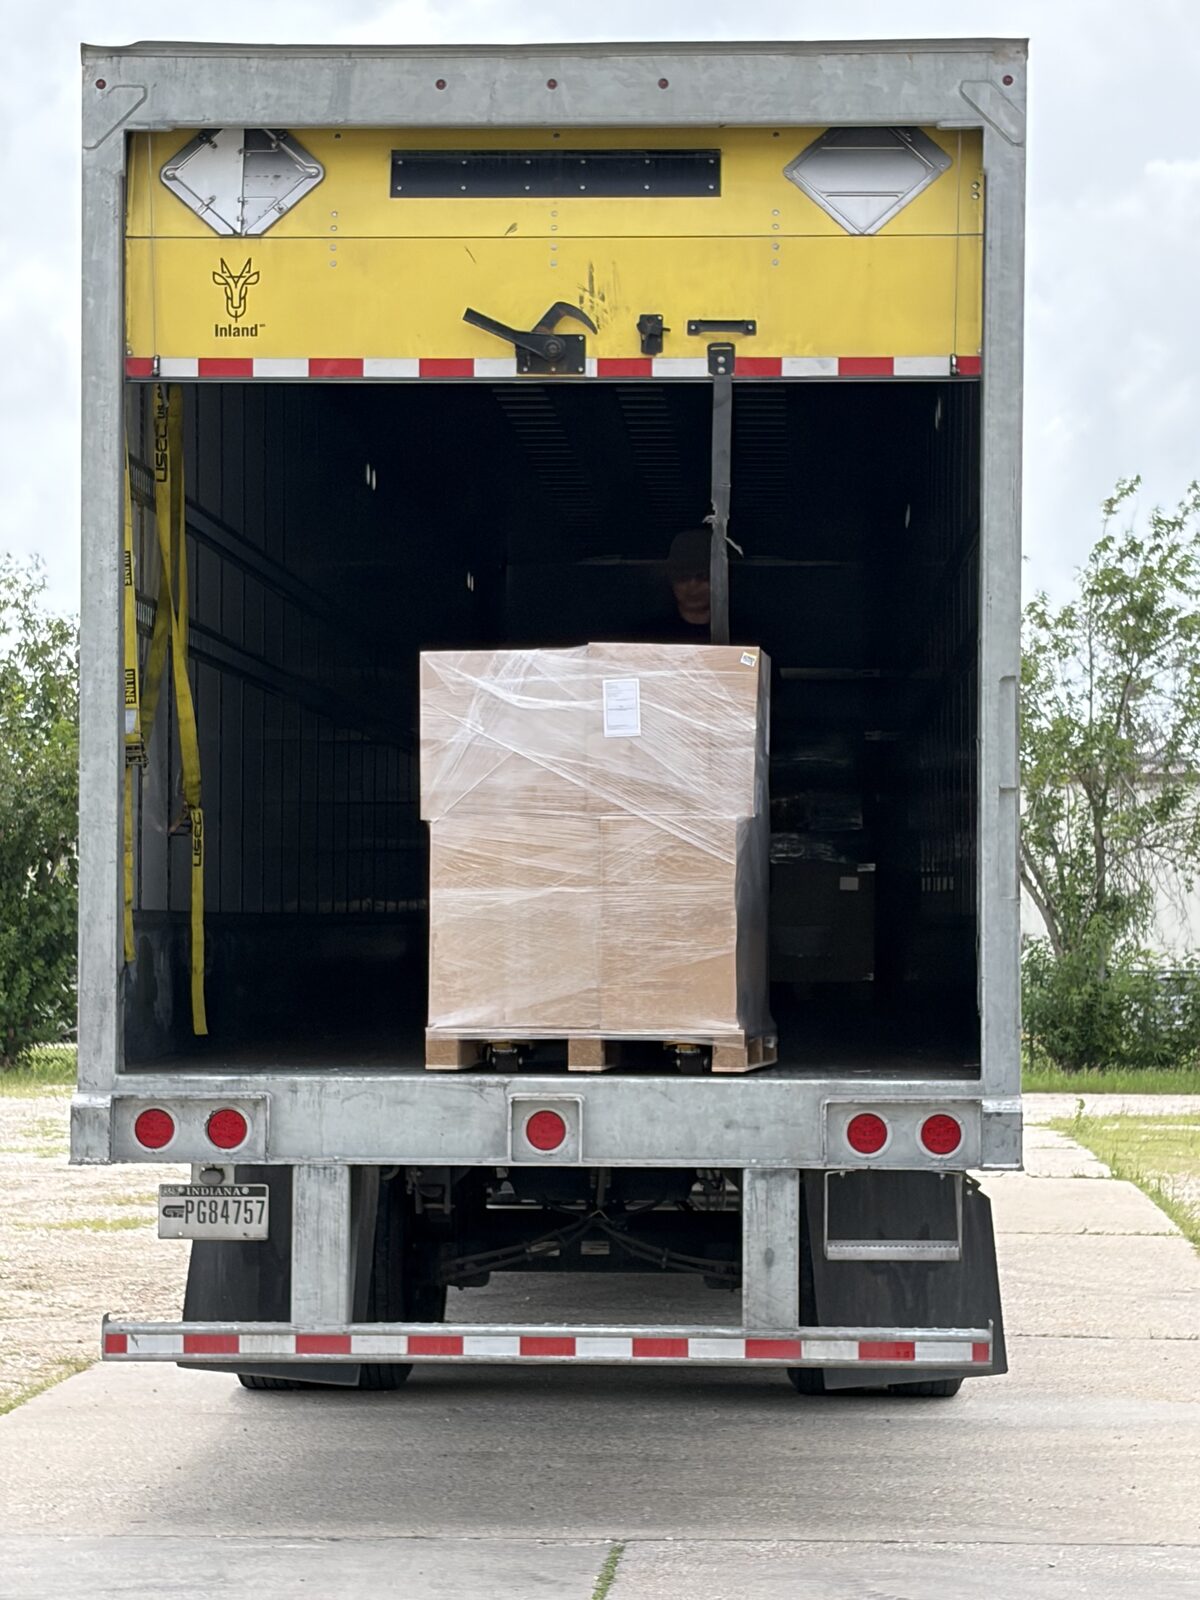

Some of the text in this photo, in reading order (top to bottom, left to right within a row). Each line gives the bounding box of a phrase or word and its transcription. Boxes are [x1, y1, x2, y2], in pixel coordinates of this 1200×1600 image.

[215, 323, 258, 337] Inland
[124, 670, 136, 704] ULINE
[186, 1186, 242, 1196] INDIANA
